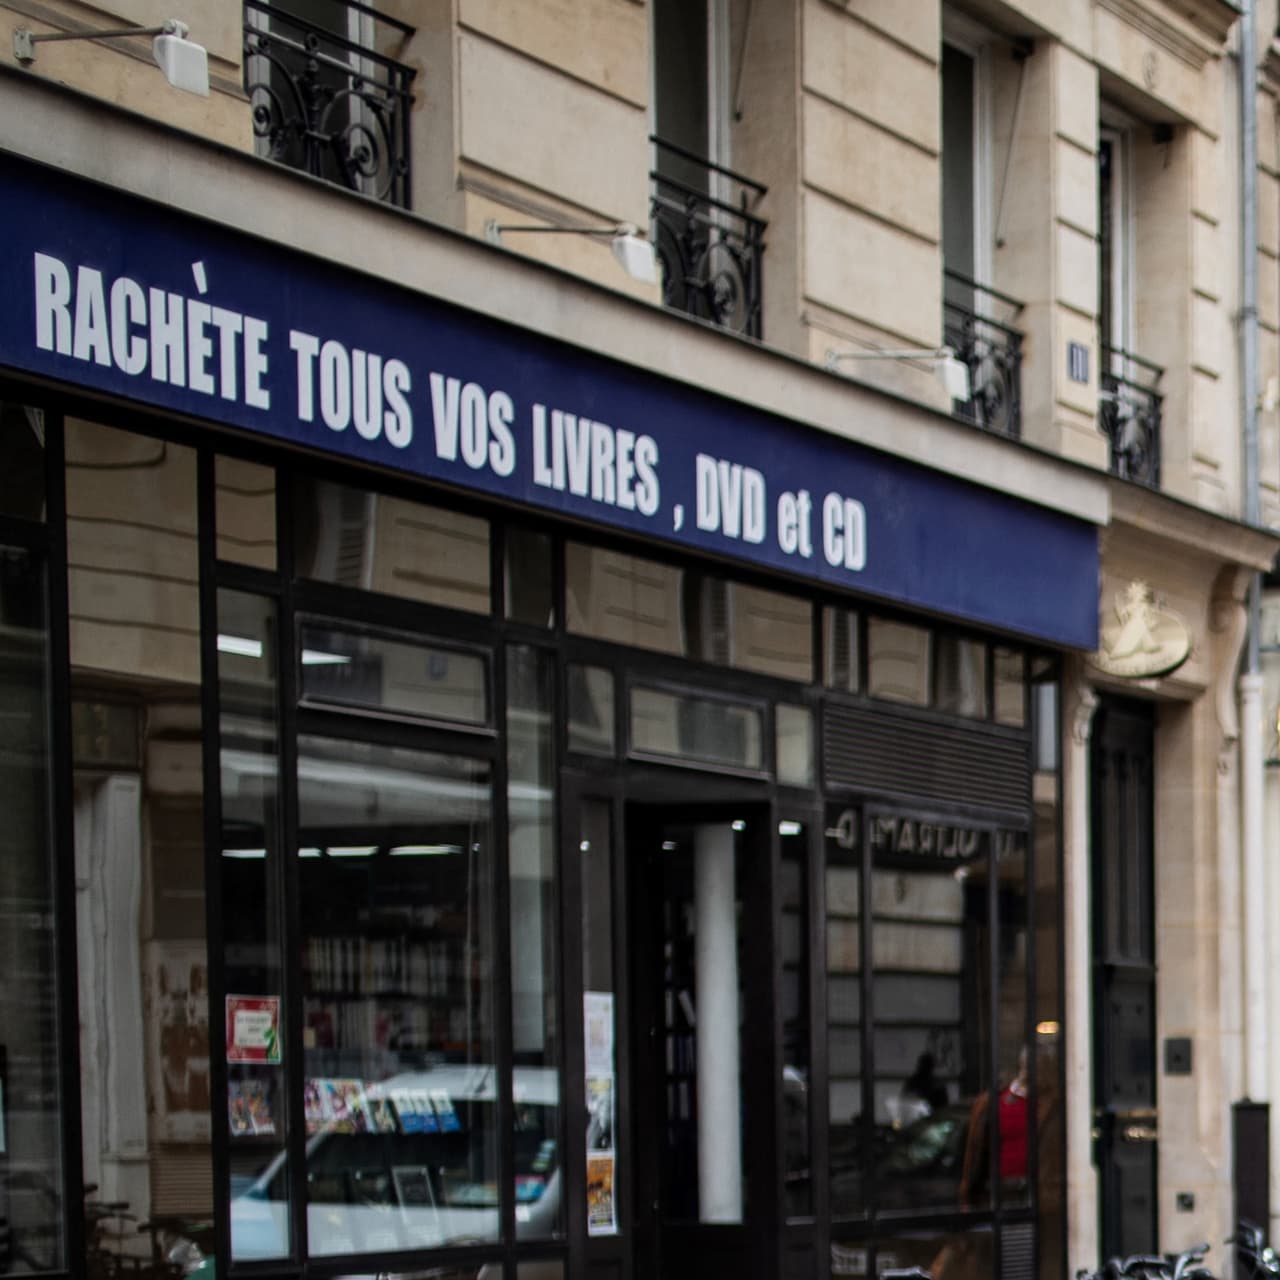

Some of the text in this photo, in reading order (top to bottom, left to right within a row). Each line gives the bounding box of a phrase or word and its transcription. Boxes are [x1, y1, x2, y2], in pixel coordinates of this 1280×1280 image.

[34, 252, 270, 410] RACHÈTE
[290, 330, 412, 448] TOUS
[430, 372, 515, 476] VOS
[696, 453, 765, 543] DVD
[778, 489, 811, 557] et
[822, 492, 866, 571] CD
